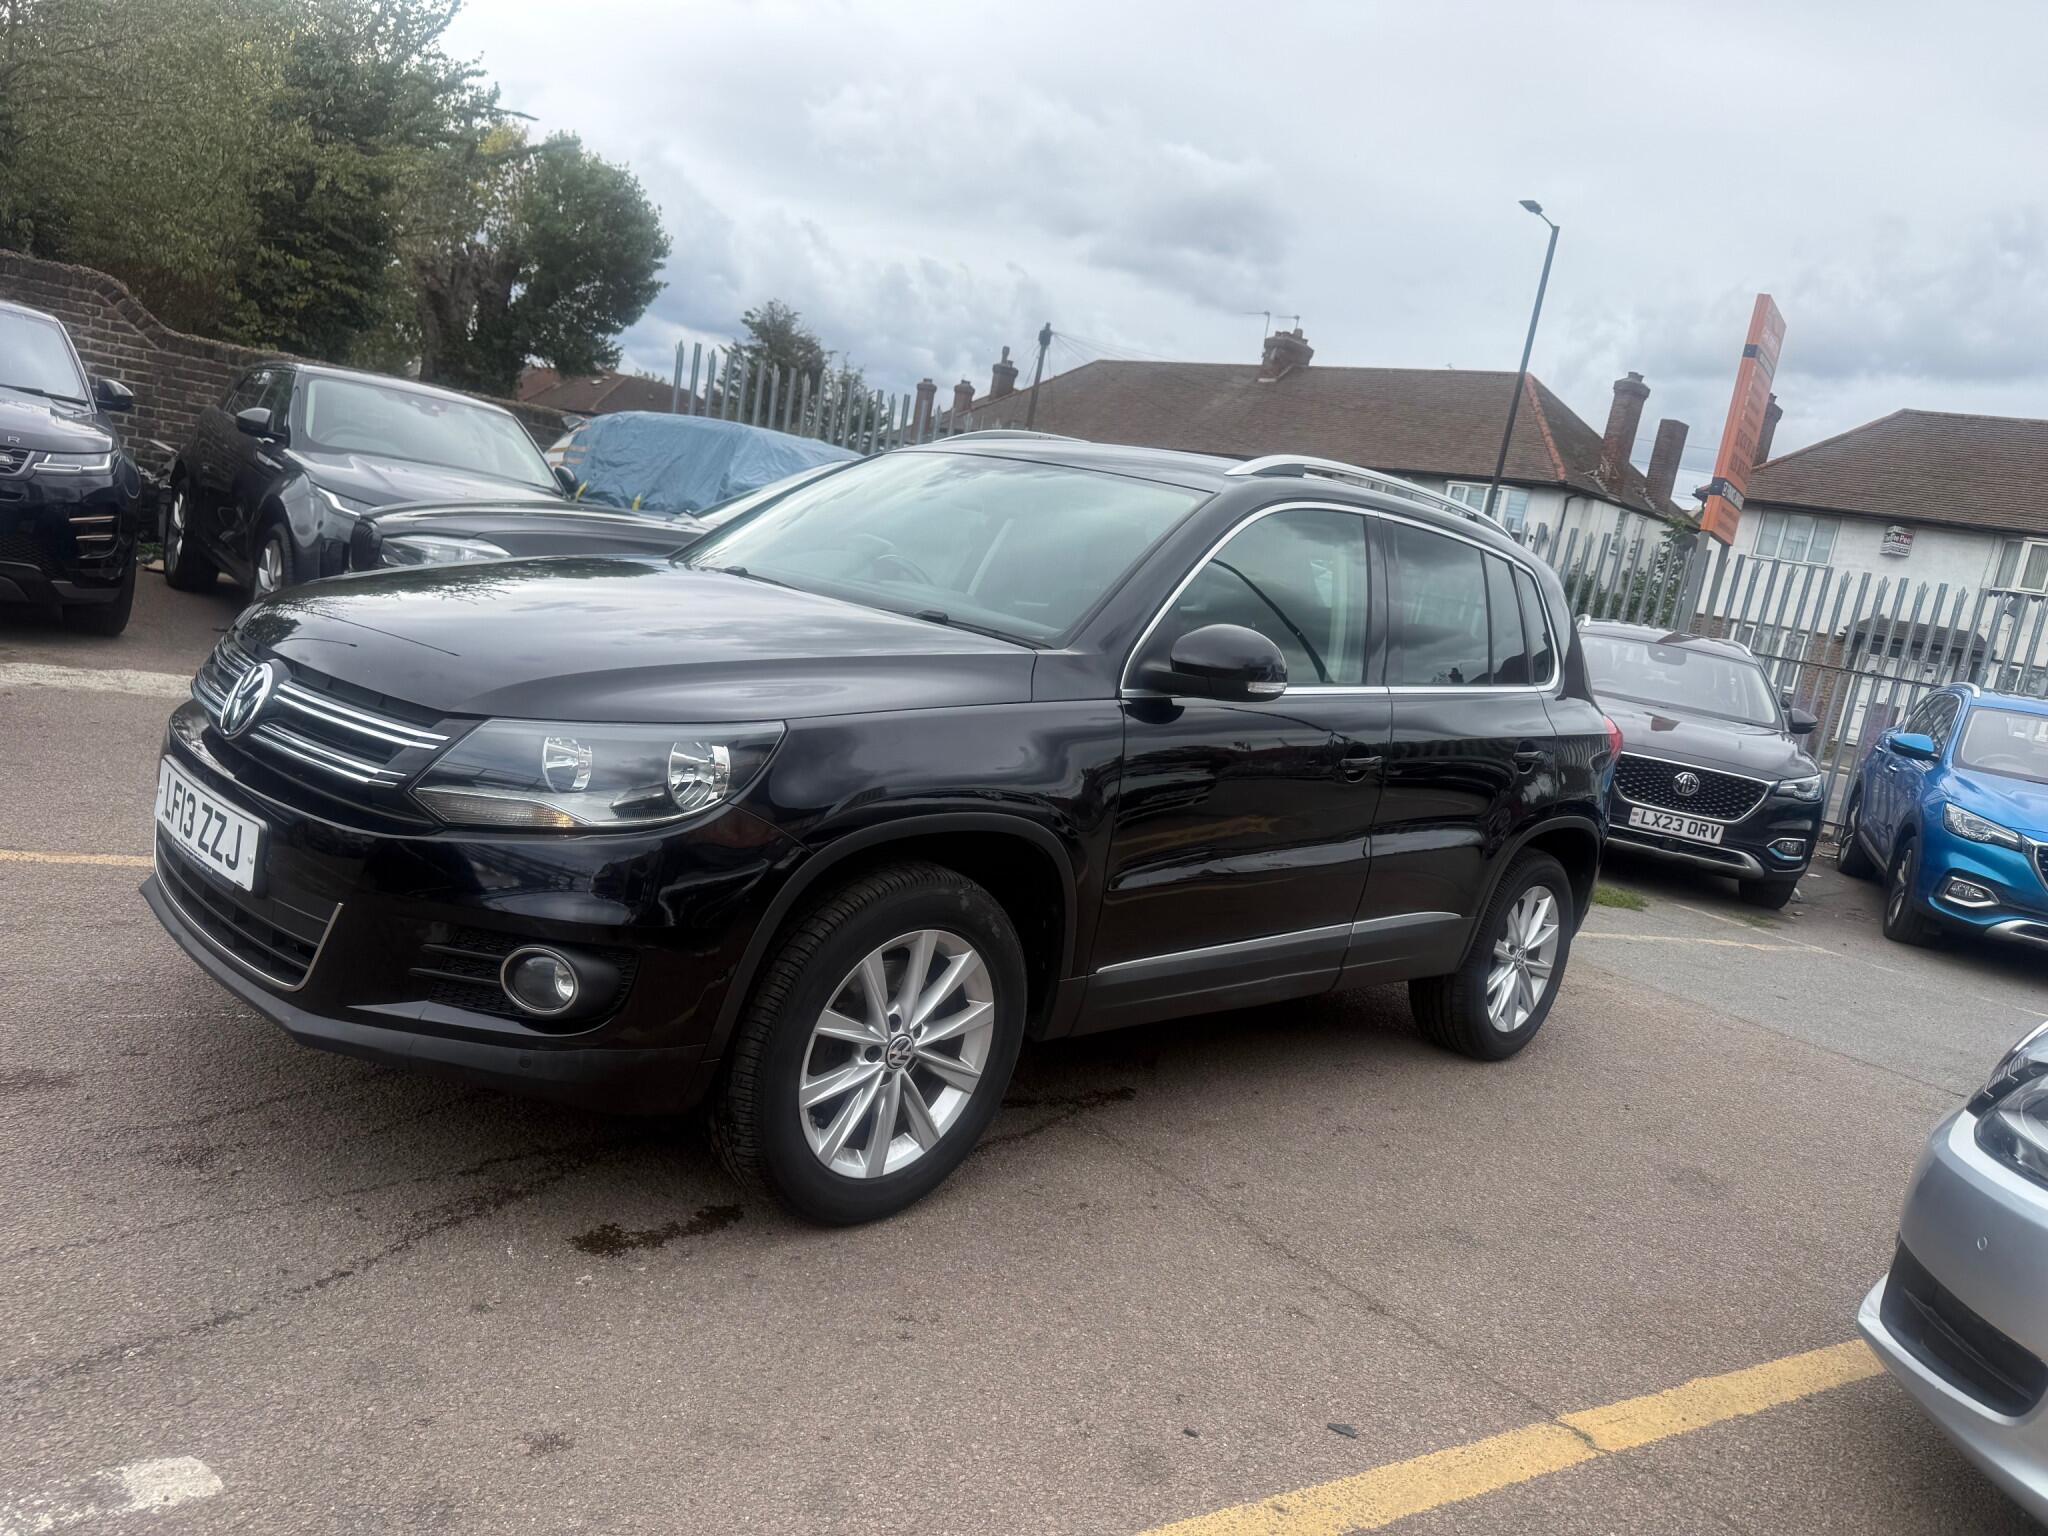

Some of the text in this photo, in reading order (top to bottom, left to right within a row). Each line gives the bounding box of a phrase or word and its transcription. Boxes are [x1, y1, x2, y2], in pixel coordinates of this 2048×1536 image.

[1675, 773, 1698, 795] MG
[163, 772, 196, 838] LF13
[197, 803, 243, 871] ZZJ
[1640, 810, 1720, 840] LX23 ORV
